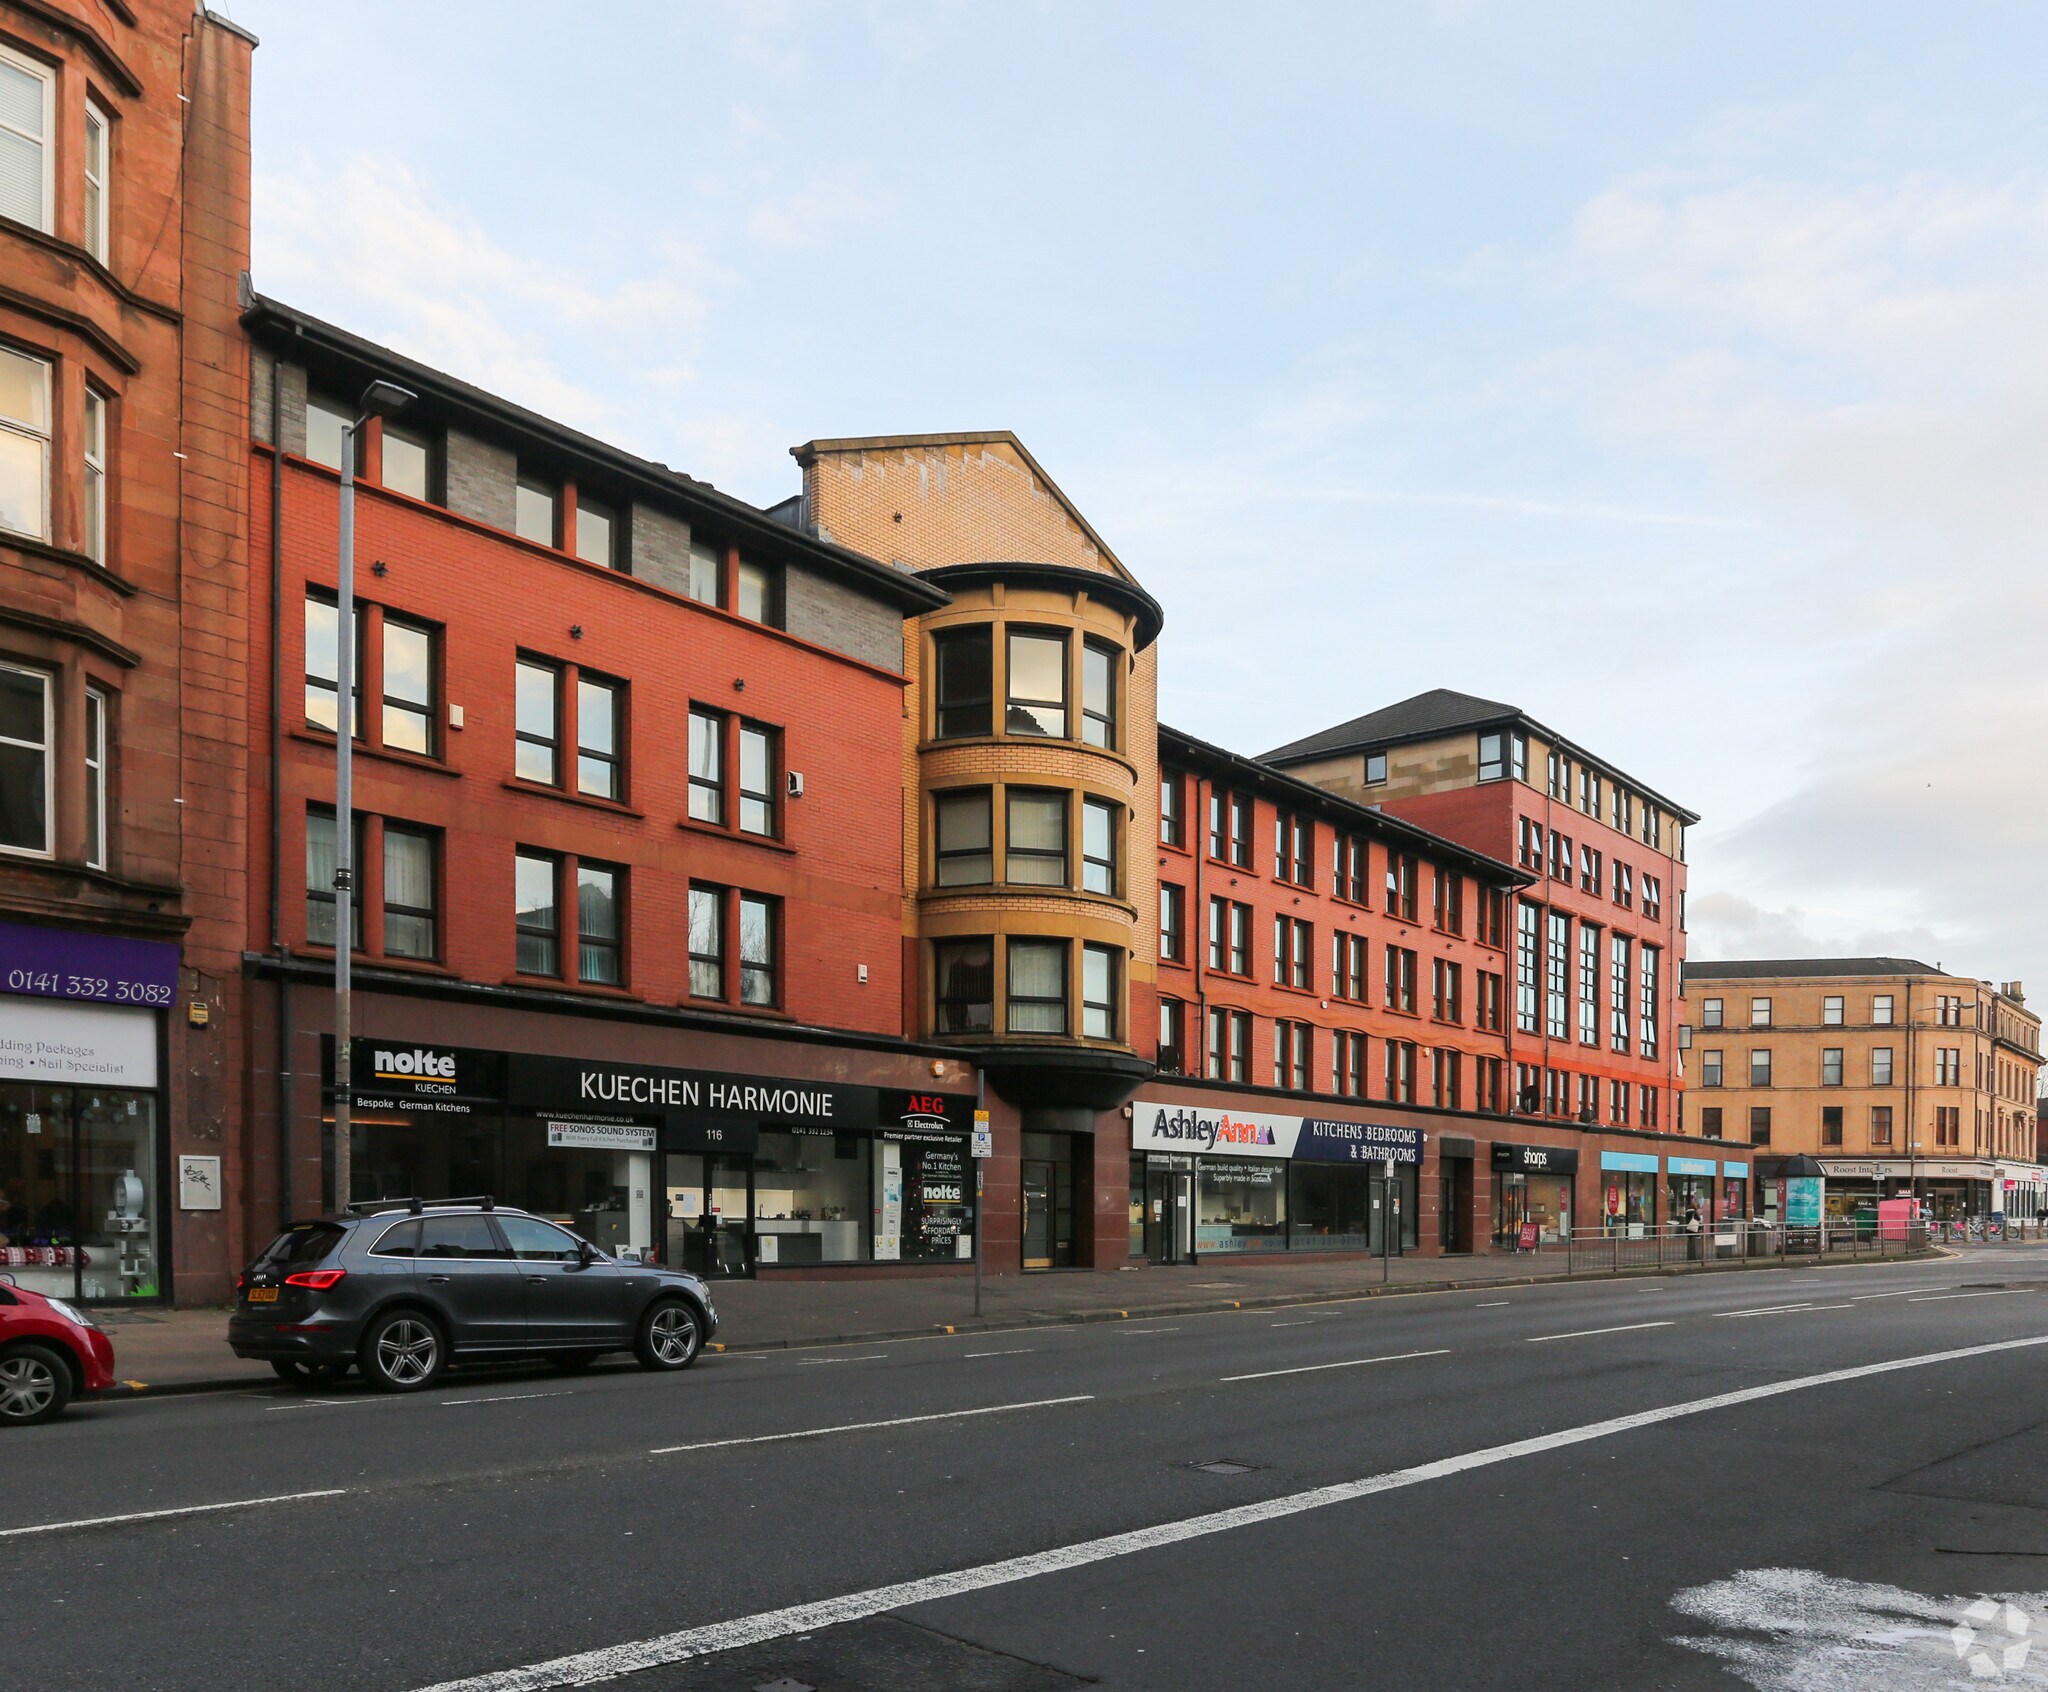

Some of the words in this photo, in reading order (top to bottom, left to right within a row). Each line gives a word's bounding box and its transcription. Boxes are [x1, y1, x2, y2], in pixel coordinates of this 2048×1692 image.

[9, 969, 58, 993] 0141
[66, 975, 109, 998] 332
[115, 981, 171, 1004] 3082
[36, 1041, 95, 1058] Packages
[38, 1058, 62, 1070] Nail
[66, 1060, 124, 1074] Specialist
[374, 1049, 456, 1077] nolte
[415, 1083, 457, 1094] KUECHEN
[580, 1072, 699, 1107] KUECHEN
[709, 1083, 833, 1117] HARMONIE
[357, 1097, 394, 1109] Bespoke
[399, 1100, 434, 1111] German
[435, 1102, 471, 1113] Kitchens
[907, 1095, 944, 1114] AEG
[536, 1111, 634, 1123] www.kuechenharmonie.co.uk
[550, 1123, 568, 1133] FREE
[569, 1124, 595, 1134] SONOS
[597, 1126, 624, 1136] SOUND
[625, 1128, 655, 1138] SYSTEM
[791, 1126, 806, 1134] 0141
[820, 1128, 833, 1136] 1234
[914, 1120, 944, 1130] Electrolux
[706, 1129, 723, 1141] 116
[883, 1131, 903, 1140] Premier
[904, 1133, 923, 1142] partner
[923, 1134, 944, 1142] exclusive
[944, 1135, 963, 1143] Retailer
[1313, 1121, 1363, 1139] KITCHENS
[1365, 1126, 1417, 1144] BEDROOMS
[925, 1151, 959, 1162] Germany's
[1350, 1144, 1358, 1158] &
[1361, 1145, 1416, 1162] BATHROOMS
[1523, 1147, 1547, 1169] sharps
[922, 1162, 937, 1170] No.1
[938, 1162, 961, 1171] Kitchen
[1197, 1162, 1216, 1171] German
[1217, 1163, 1228, 1171] build
[1229, 1165, 1243, 1173] quality
[1833, 1165, 1856, 1173] Roost
[1941, 1166, 1958, 1174] Roost
[1213, 1173, 1233, 1183] Superbly
[923, 1184, 961, 1200] nolte
[921, 1217, 962, 1225] SURPRISINGLY
[923, 1226, 961, 1235] AFFORDABLE
[931, 1237, 952, 1245] PRICES
